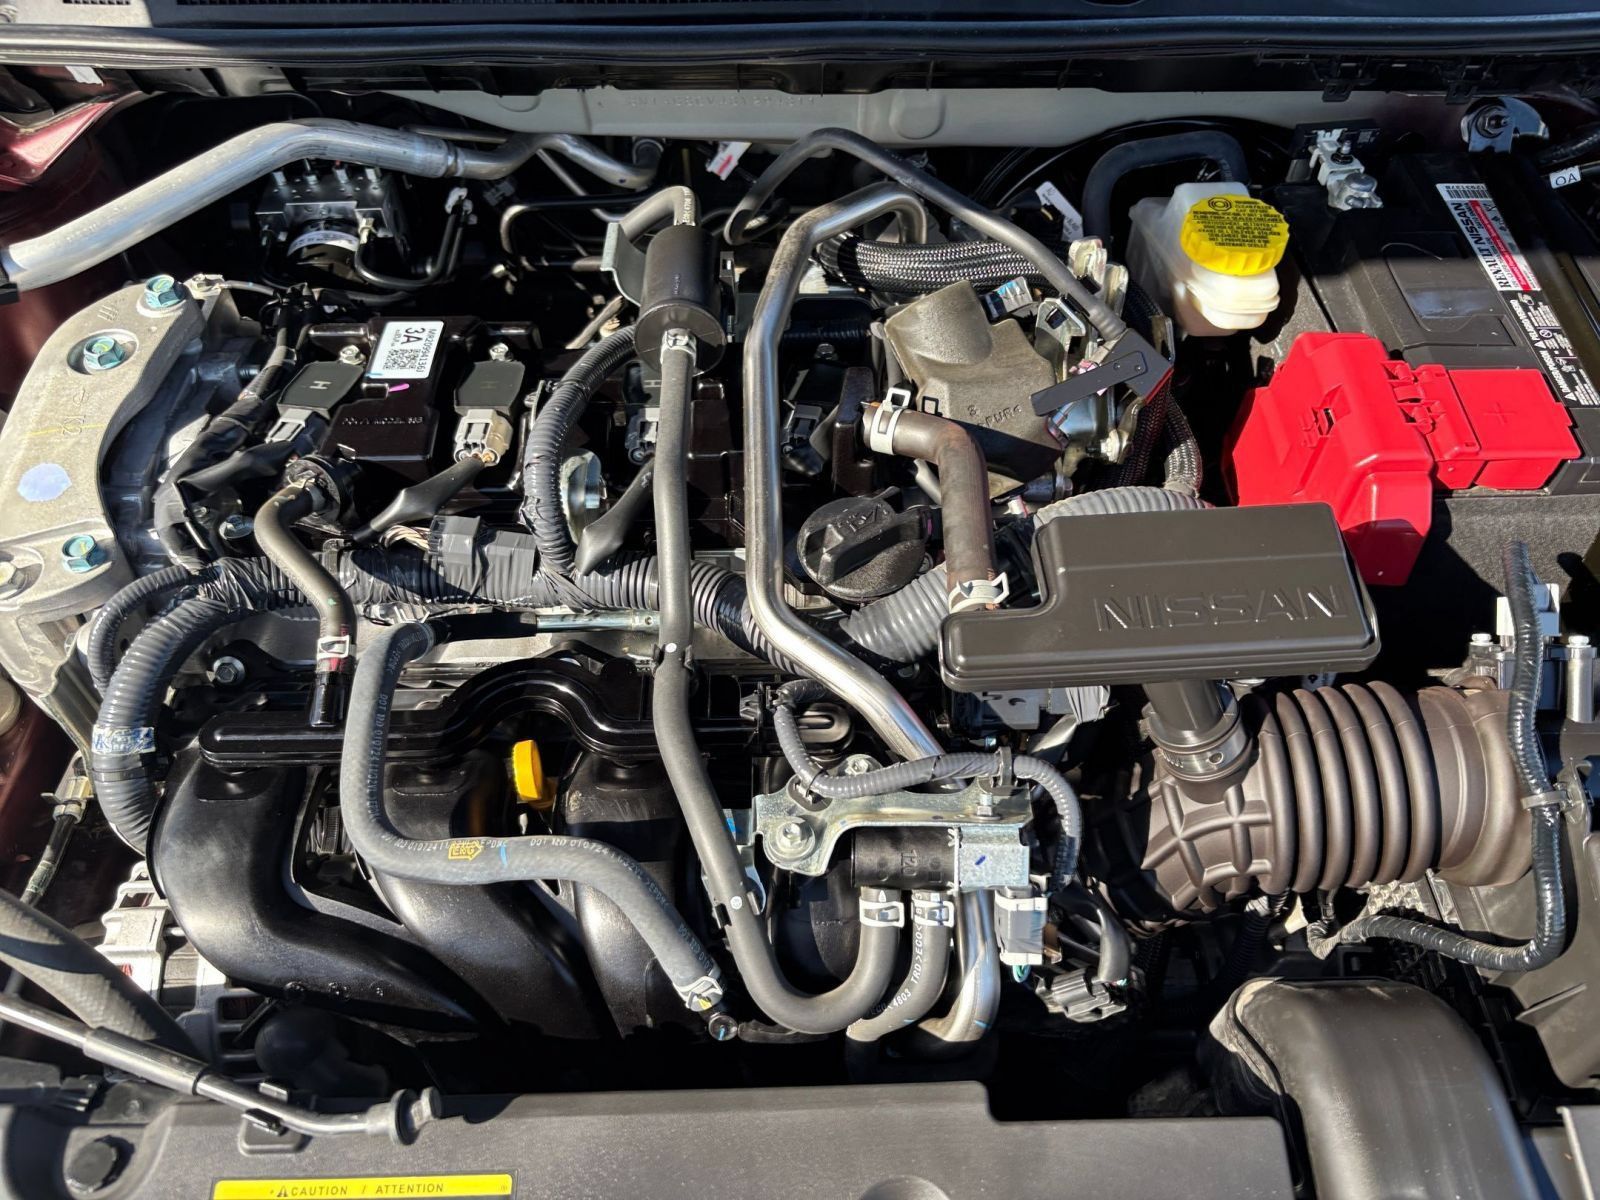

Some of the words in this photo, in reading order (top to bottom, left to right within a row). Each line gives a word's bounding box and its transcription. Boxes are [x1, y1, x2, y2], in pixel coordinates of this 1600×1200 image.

[1451, 202, 1486, 246] NISSAN
[1478, 246, 1511, 289] RENAULT
[400, 327, 426, 344] 3A
[1094, 583, 1347, 632] NISSAN
[451, 845, 475, 857] ENG
[291, 1185, 348, 1196] CAUTION
[375, 1183, 444, 1194] ATTENTION
